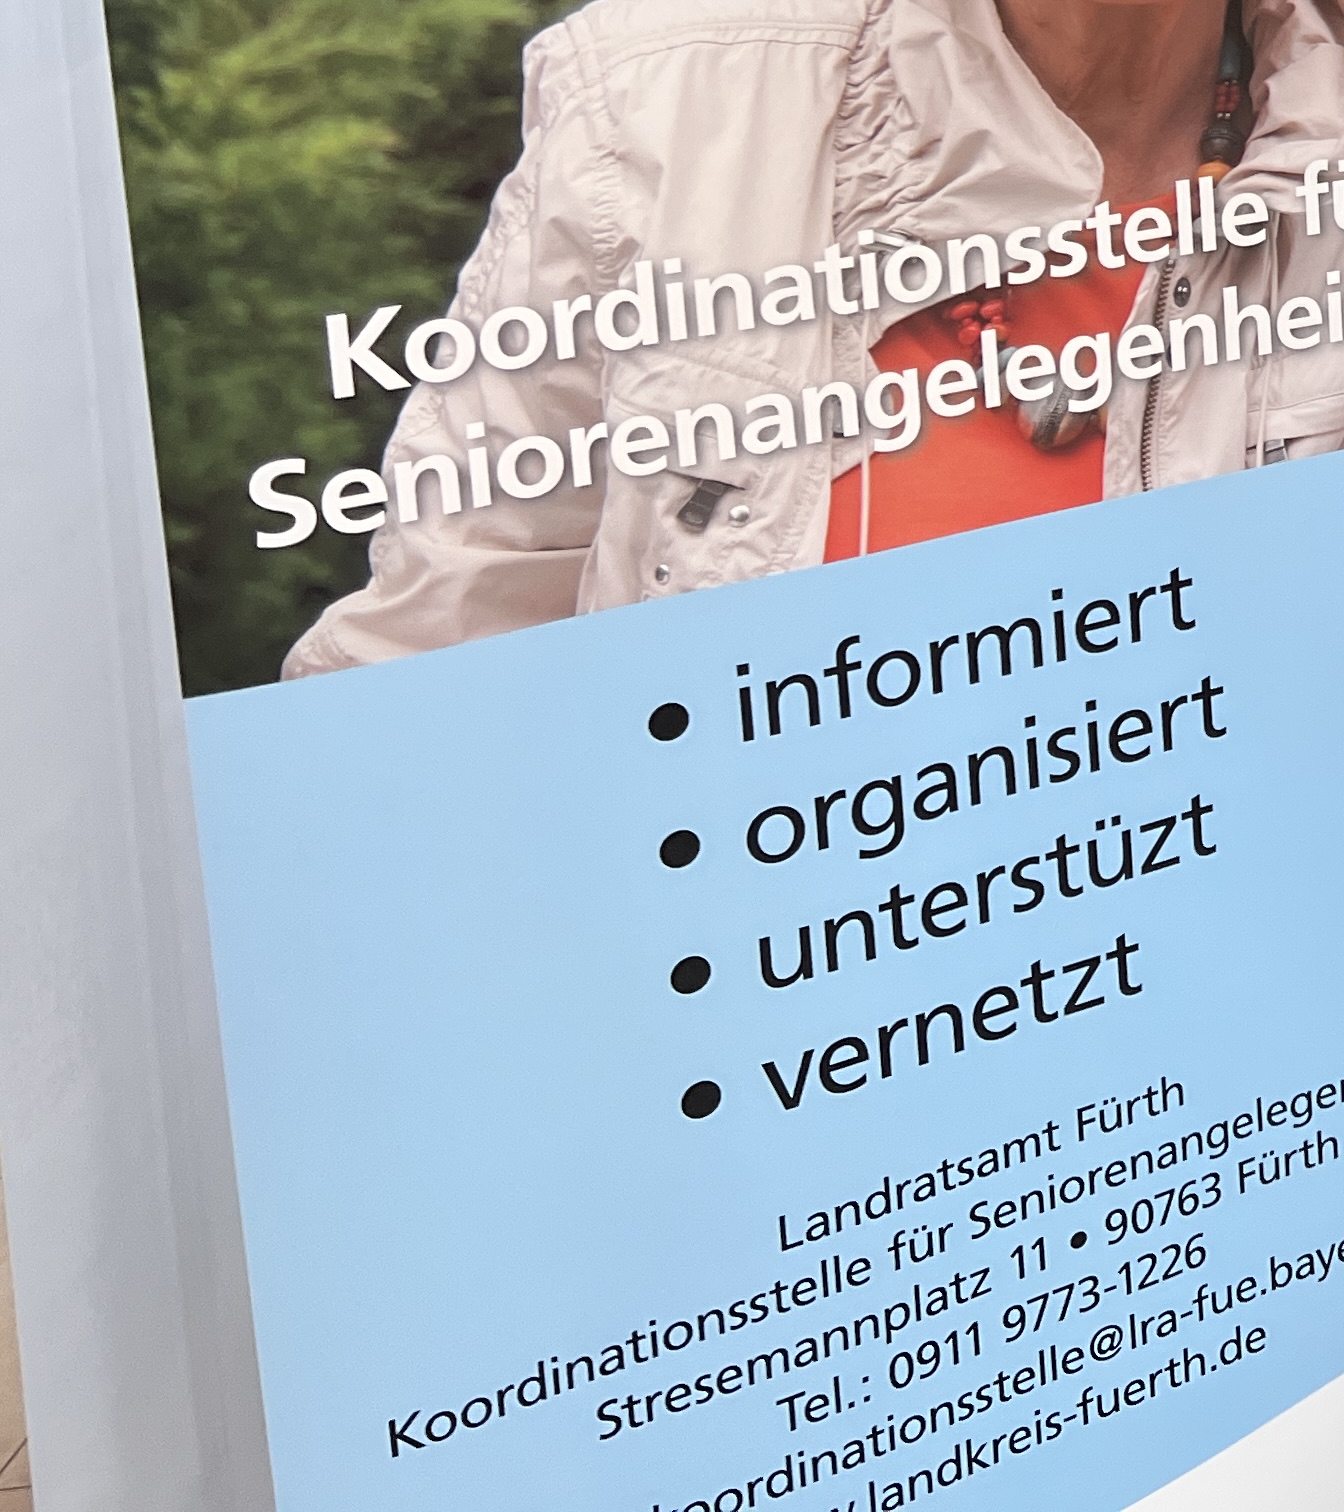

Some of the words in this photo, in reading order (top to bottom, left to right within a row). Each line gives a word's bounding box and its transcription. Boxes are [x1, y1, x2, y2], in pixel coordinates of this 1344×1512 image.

[323, 174, 1269, 401] Koordinationsstelle
[735, 566, 1197, 743] informiert
[745, 675, 1227, 864] organisiert
[758, 793, 1218, 990] unterstüzt
[761, 932, 1144, 1111] vernetzt
[777, 1120, 1062, 1252] Landratsamt
[1075, 1076, 1186, 1143] Fürth
[387, 1254, 872, 1459] Koordinationsstelle
[886, 1221, 954, 1272] für
[596, 1264, 993, 1441] Stresemannplatz
[1010, 1236, 1049, 1281] 11
[1105, 1170, 1223, 1246] 90763
[1237, 1130, 1340, 1195] Fürth
[775, 1377, 872, 1434] Tel.:
[887, 1321, 984, 1391] 0911
[1001, 1233, 1208, 1345] 9773-1226
